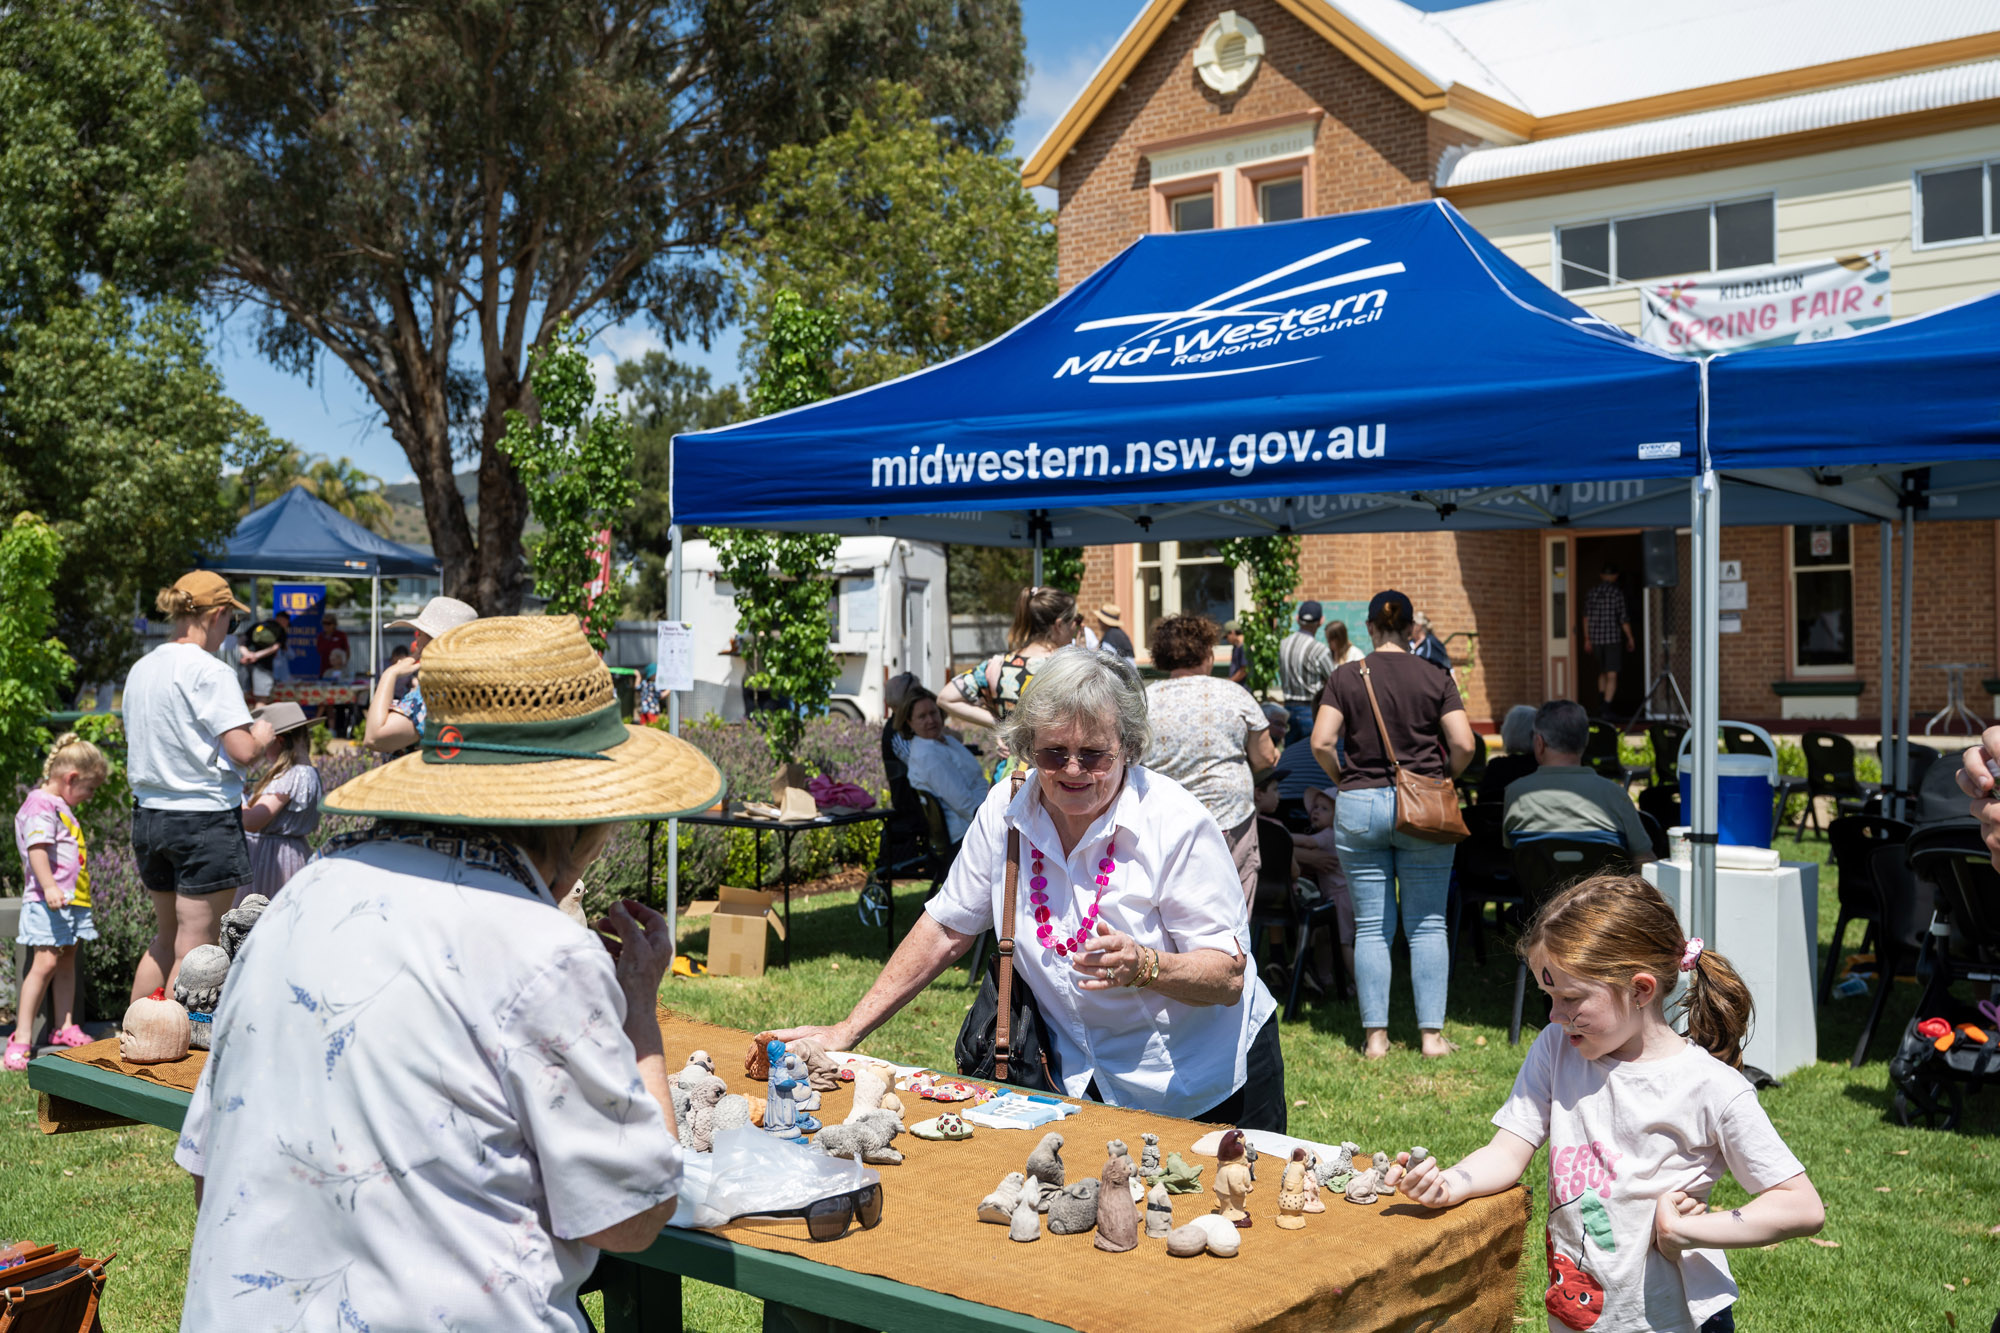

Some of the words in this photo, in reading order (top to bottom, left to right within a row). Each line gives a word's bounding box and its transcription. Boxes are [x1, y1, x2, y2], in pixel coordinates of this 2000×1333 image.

[1667, 303, 1777, 346] SPRING
[1790, 285, 1865, 324] FAIR
[1719, 274, 1804, 301] KILDALLON
[1052, 288, 1389, 379] Mid-Western
[1170, 333, 1283, 367] Regional
[1286, 307, 1384, 342] Council
[871, 422, 1387, 488] midwestern.nsw.gov.au
